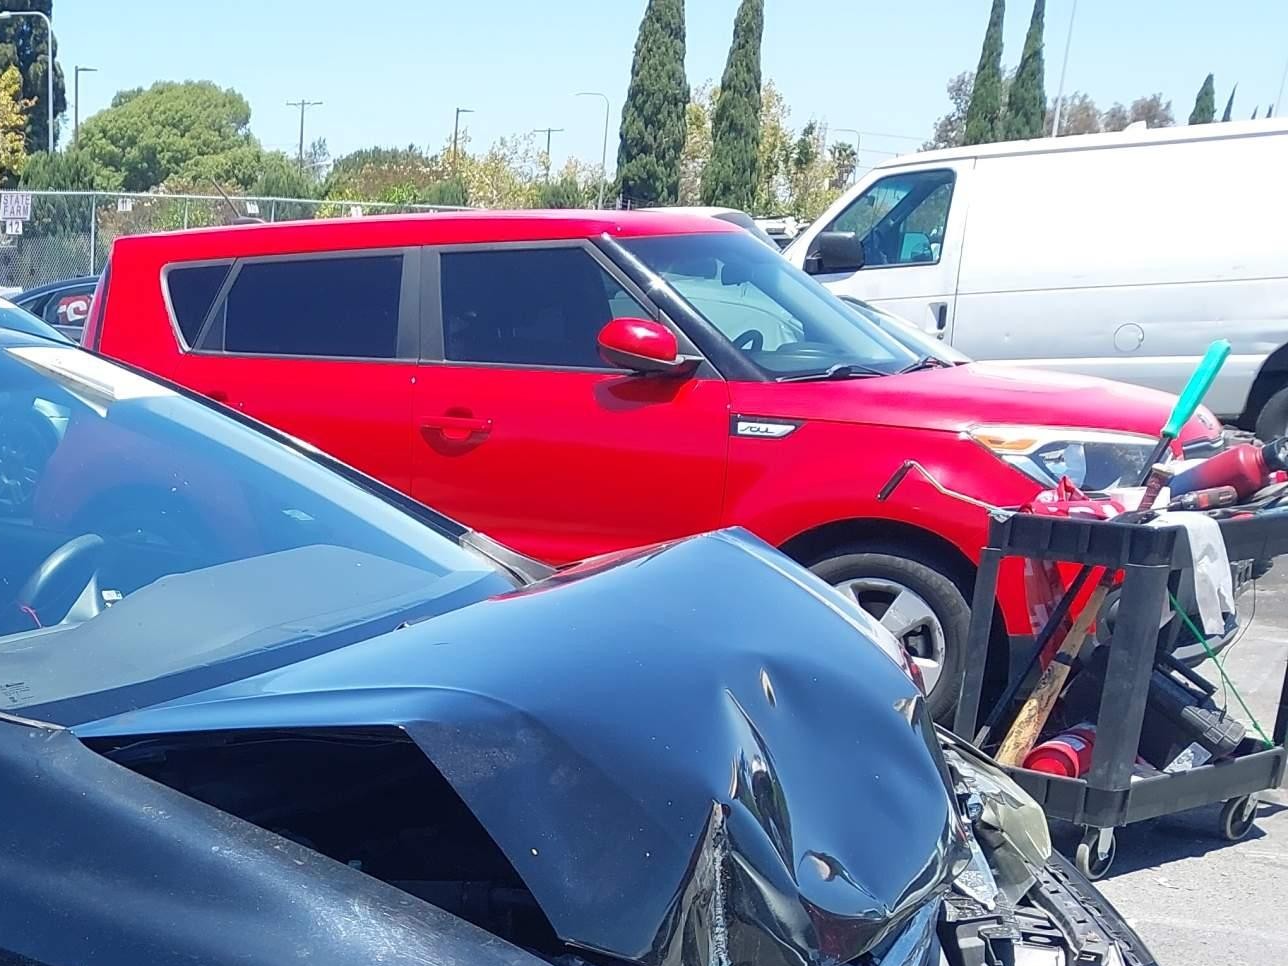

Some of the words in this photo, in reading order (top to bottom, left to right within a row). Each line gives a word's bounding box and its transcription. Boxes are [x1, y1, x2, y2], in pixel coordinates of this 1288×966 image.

[3, 194, 30, 206] STATE
[4, 205, 29, 217] FARM
[9, 222, 20, 233] 12
